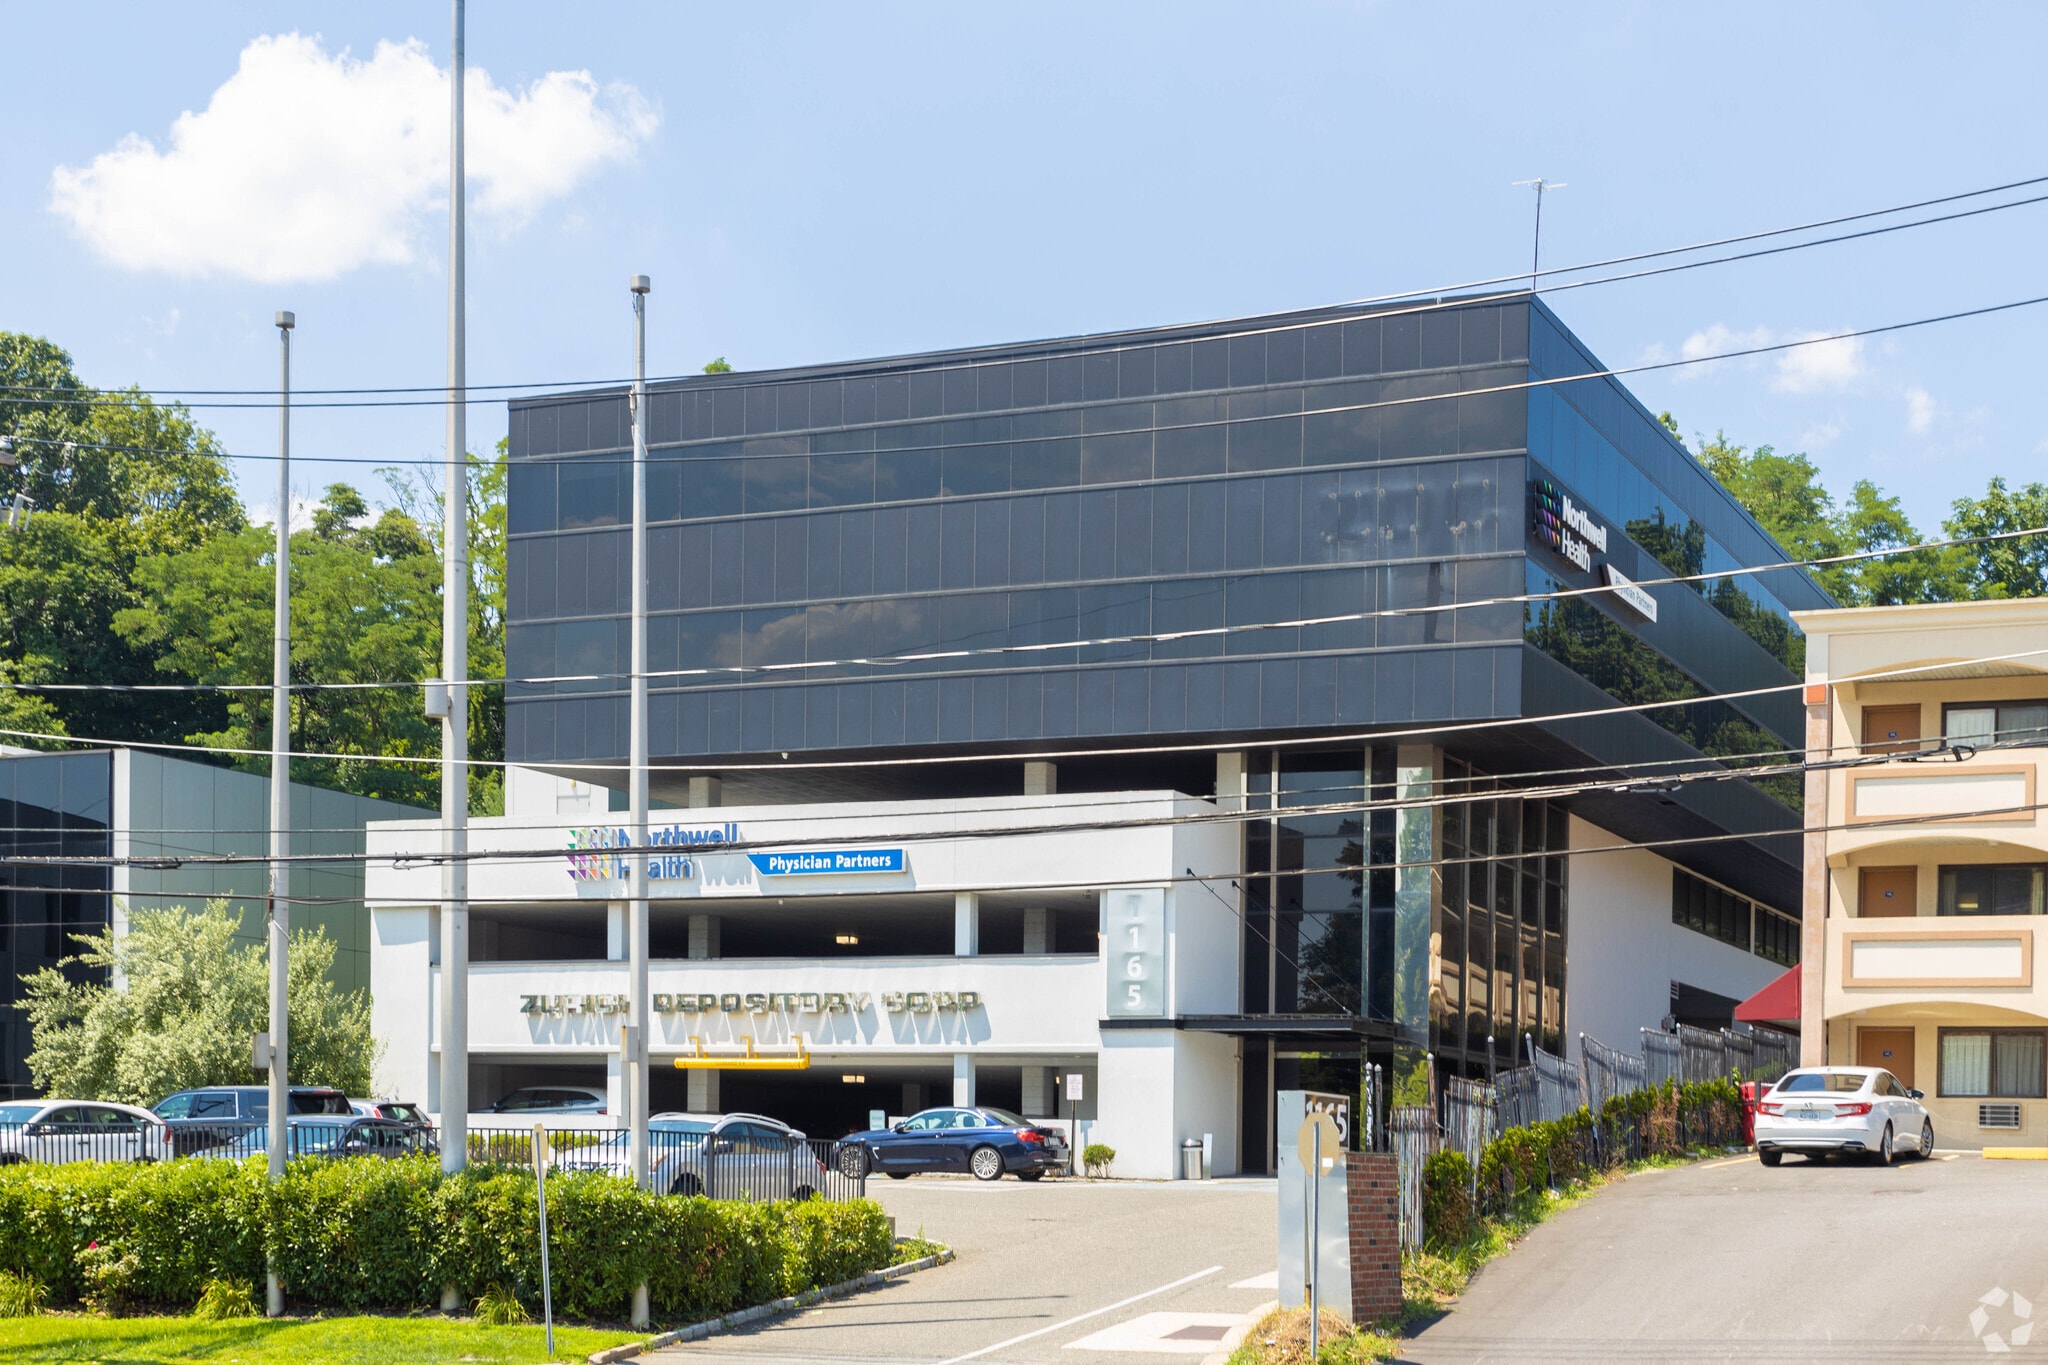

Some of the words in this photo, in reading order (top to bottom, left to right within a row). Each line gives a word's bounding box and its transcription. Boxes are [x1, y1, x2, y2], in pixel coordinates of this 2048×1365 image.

[1562, 495, 1607, 554] Northwell
[1561, 528, 1591, 573] Health
[618, 823, 738, 848] Nrthwell
[618, 855, 691, 880] Halth
[769, 855, 831, 874] Physician
[836, 854, 892, 868] Partners
